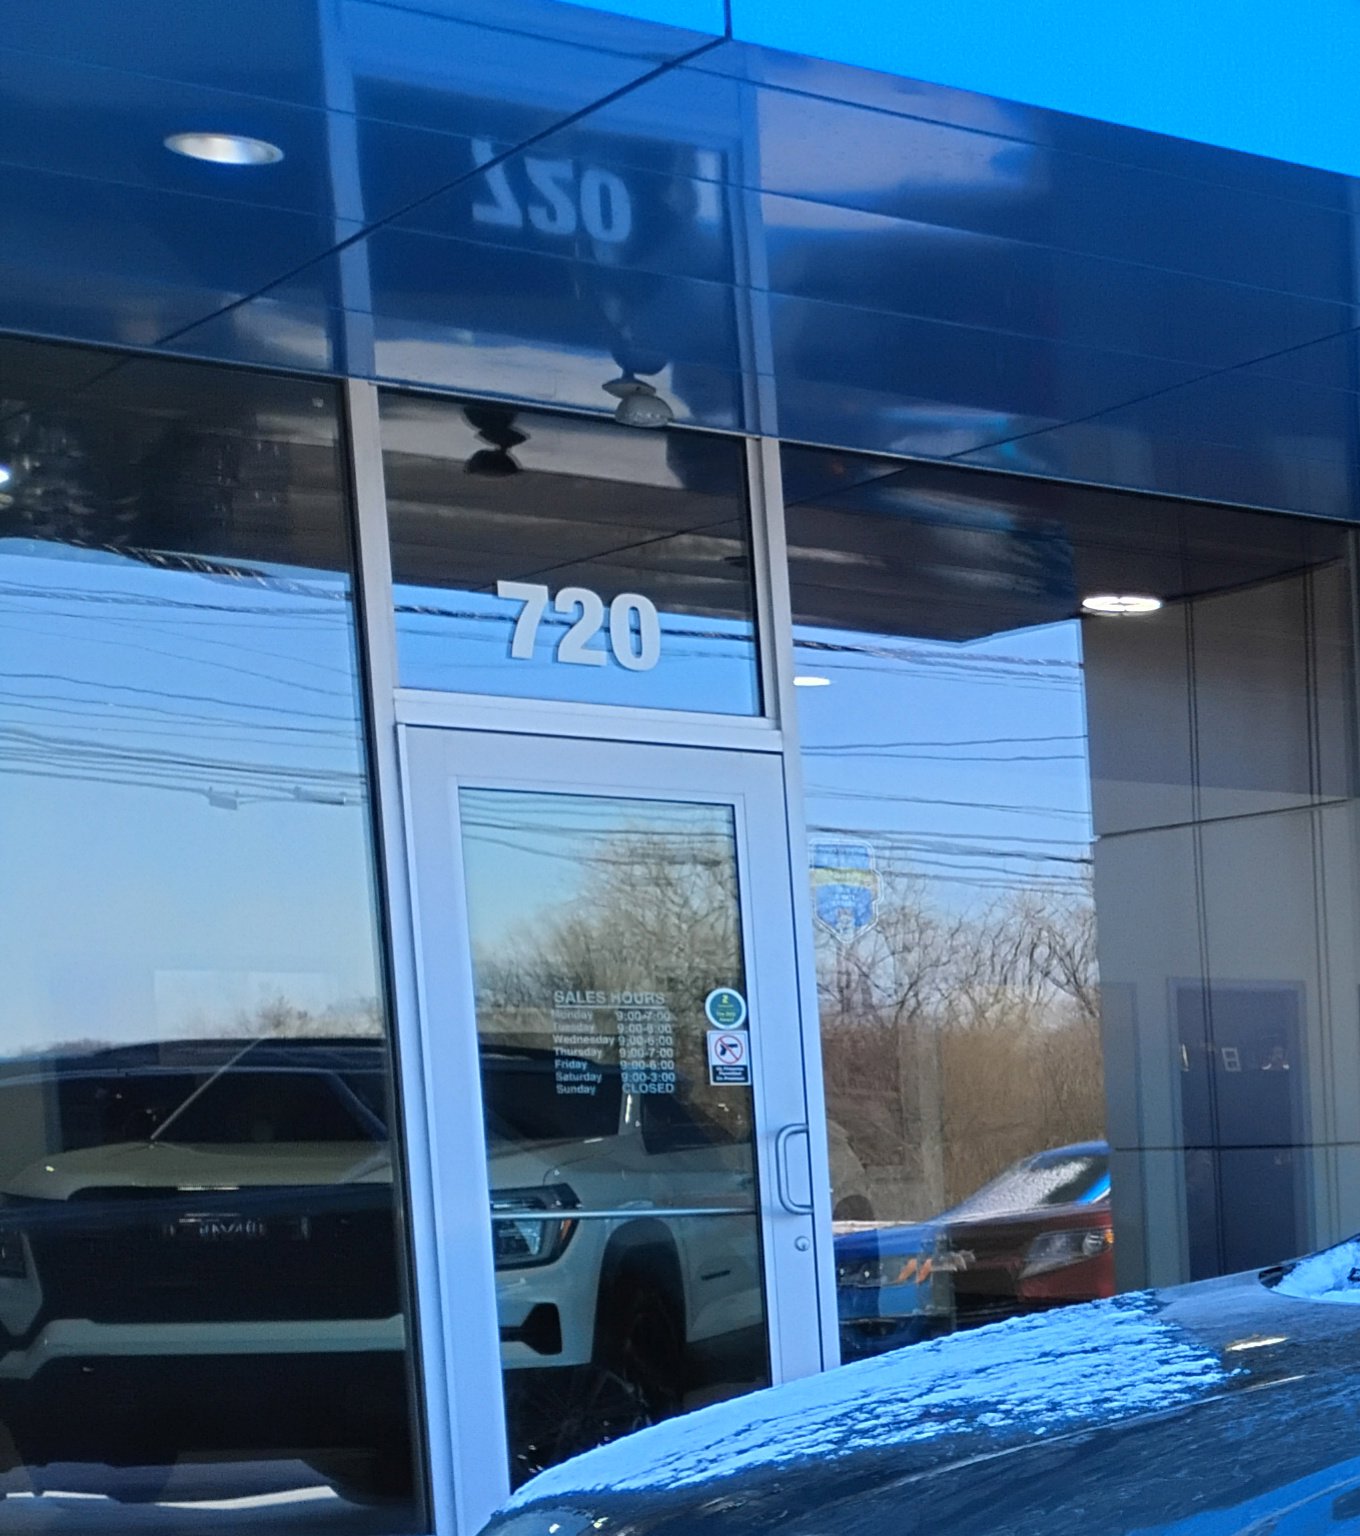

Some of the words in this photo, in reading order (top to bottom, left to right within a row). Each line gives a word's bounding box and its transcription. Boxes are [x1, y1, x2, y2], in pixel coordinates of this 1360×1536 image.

[496, 579, 661, 672] 720
[554, 990, 606, 1004] SALES
[610, 991, 666, 1005] HOURS
[553, 1034, 615, 1046] Wednesday
[553, 1046, 602, 1058] Thursday
[619, 1047, 674, 1058] 9:00-7:00
[555, 1059, 588, 1070] Friday
[555, 1071, 602, 1084] Saturday
[621, 1072, 676, 1083] 9:00-3:00
[556, 1084, 596, 1095] Sunday
[622, 1083, 675, 1094] CLOSED
